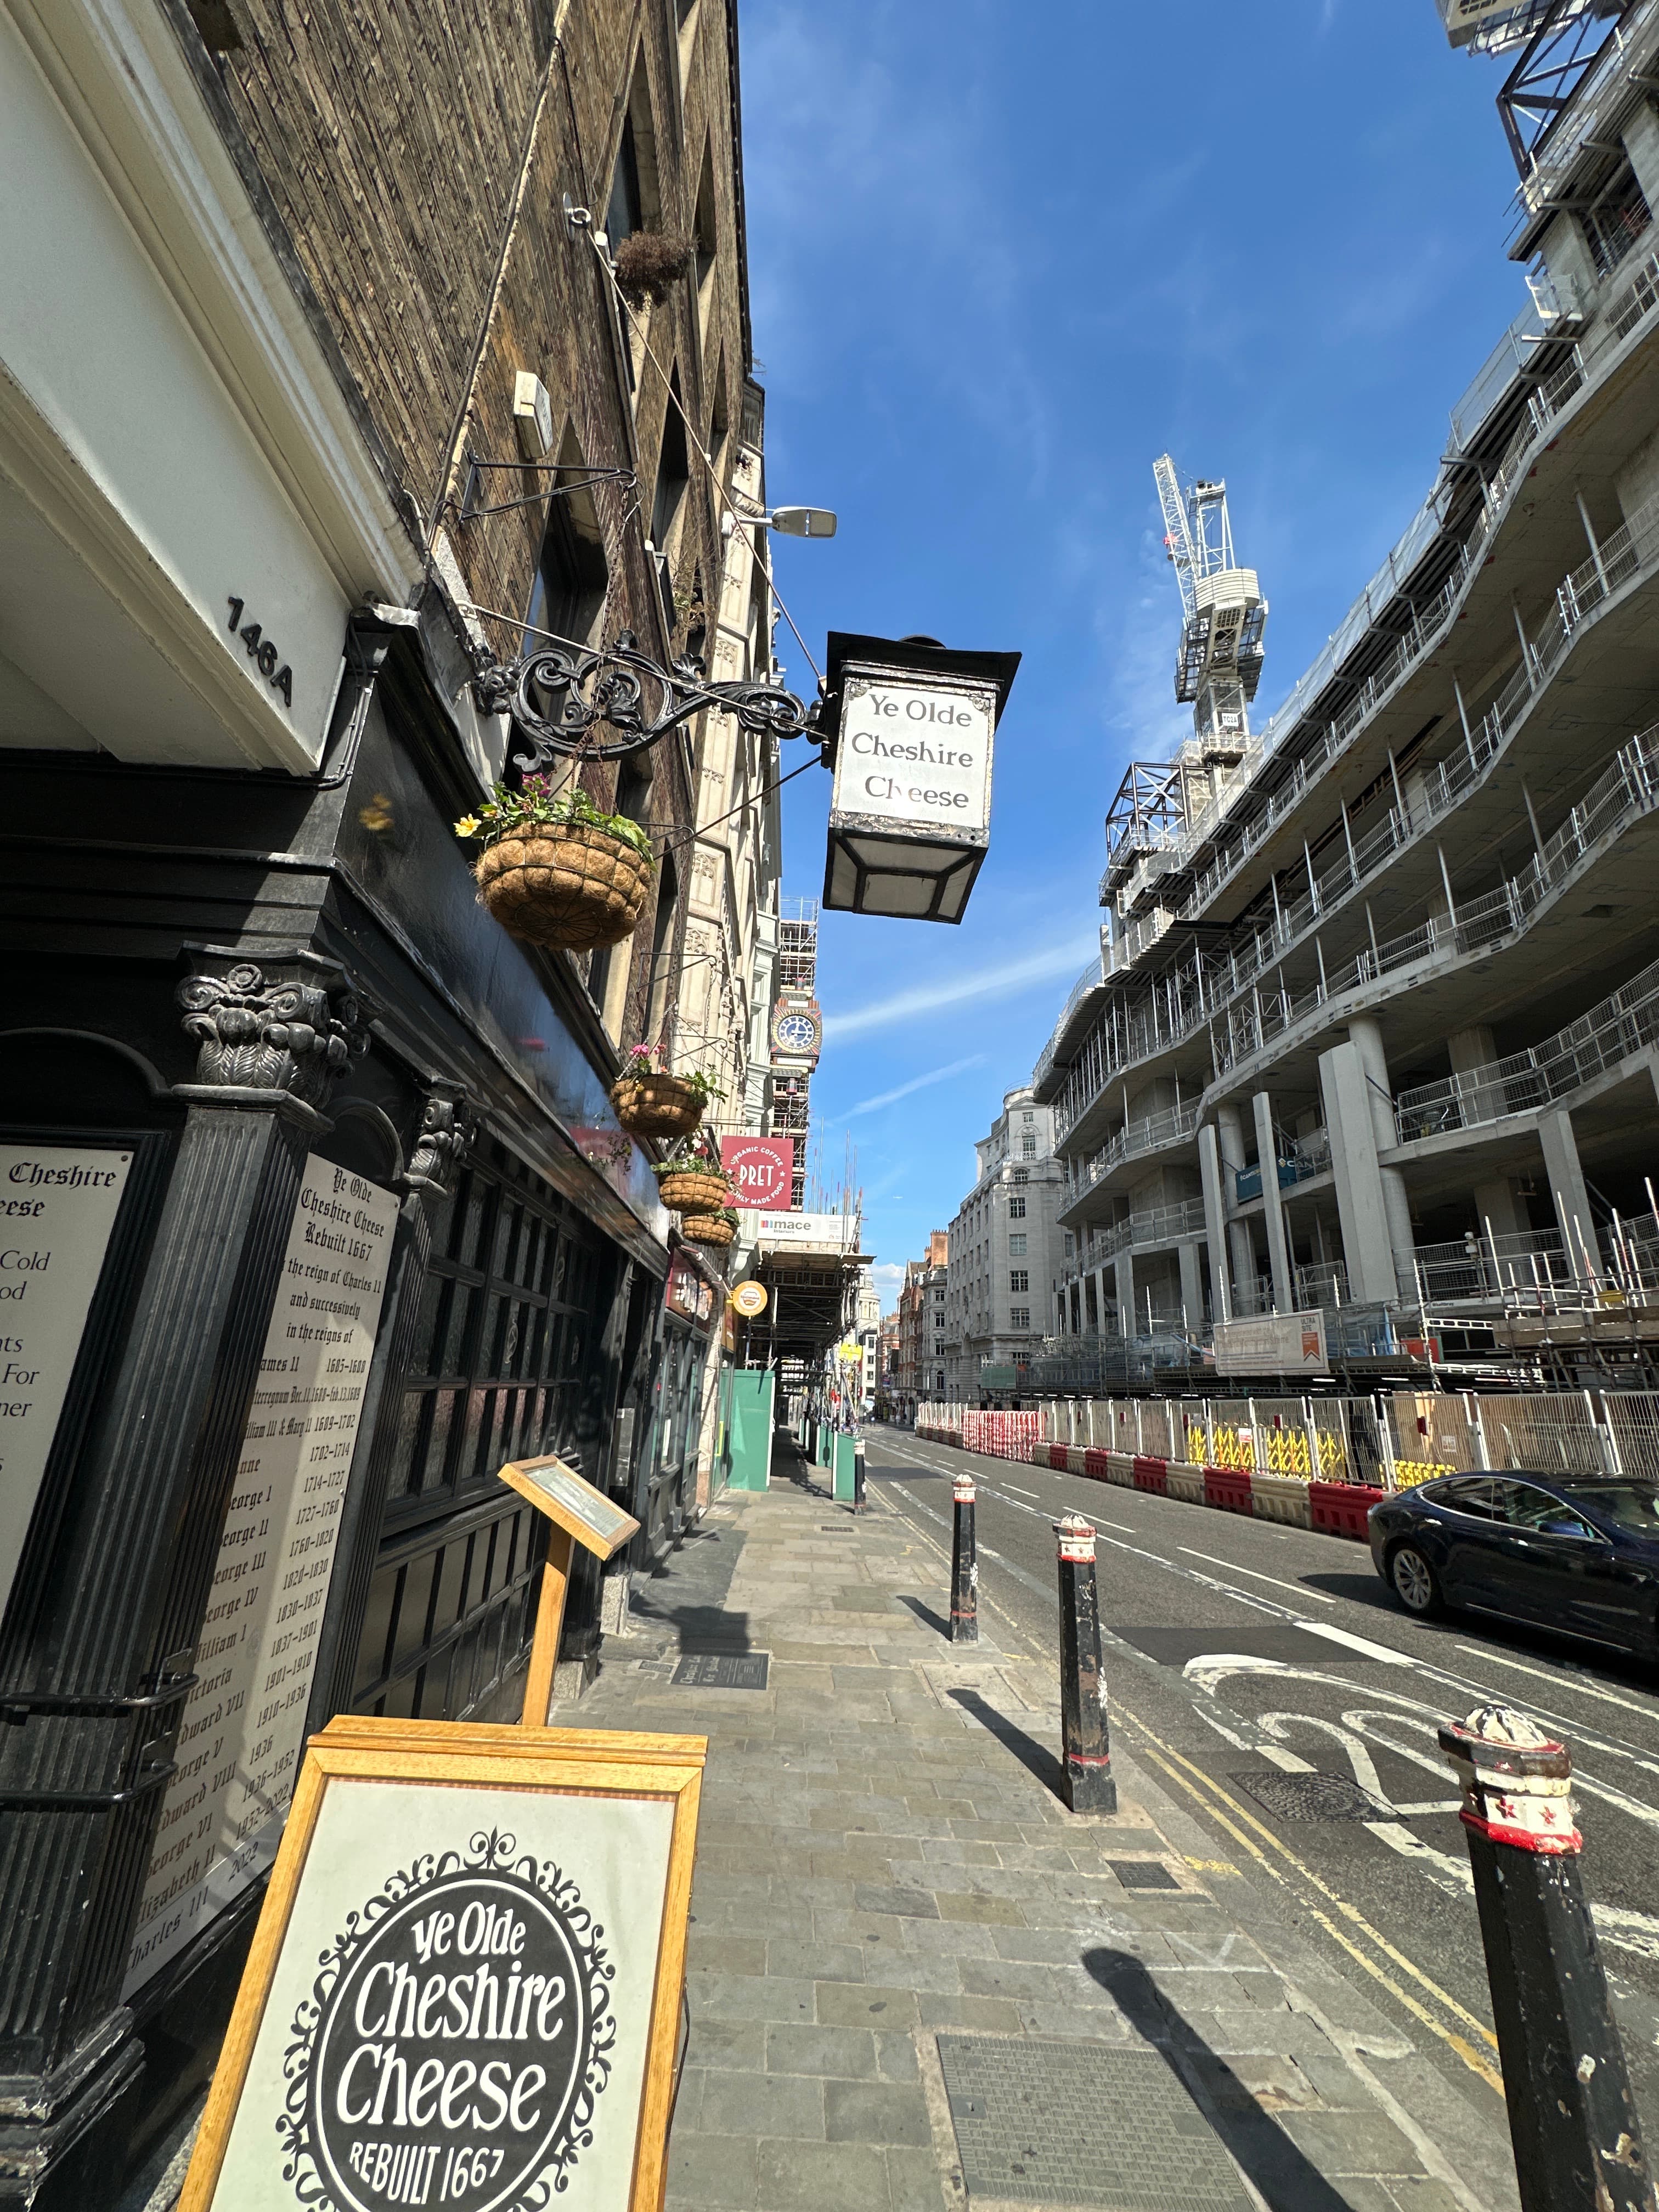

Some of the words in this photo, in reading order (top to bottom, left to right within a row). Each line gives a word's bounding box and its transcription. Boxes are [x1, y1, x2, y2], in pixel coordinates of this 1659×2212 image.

[228, 596, 292, 707] 146A
[868, 694, 899, 717] Ye
[906, 701, 972, 727] Olde
[851, 732, 974, 768] Cheshire
[865, 776, 969, 809] Cheese
[730, 1146, 759, 1165] ORGANIC
[760, 1147, 783, 1167] COFFEE
[9, 1162, 117, 1190] Cheshire
[333, 1167, 347, 1194] Ye
[351, 1176, 372, 1203] Olde
[739, 1164, 774, 1186] PRET
[751, 1195, 771, 1205] MADE
[770, 1181, 785, 1198] FOOD
[301, 1187, 351, 1224] Cheshire
[354, 1209, 384, 1238] Cheese
[774, 1220, 811, 1230] mace
[304, 1221, 346, 1252] Rebuilt
[348, 1239, 373, 1261] 1667
[1, 1250, 51, 1271] Cold
[287, 1257, 303, 1278] the
[305, 1265, 329, 1284] reign
[330, 1269, 341, 1284] of
[343, 1271, 371, 1291] Charles
[290, 1291, 308, 1307] and
[309, 1297, 360, 1320] successively
[286, 1323, 296, 1338] in
[298, 1323, 312, 1343] the
[314, 1327, 341, 1345] reigns
[343, 1329, 354, 1344] of
[2, 1363, 40, 1385] For
[260, 1358, 288, 1372] ames
[254, 1390, 289, 1408] terregnum
[246, 1421, 266, 1439] illiam
[286, 1418, 305, 1438] Mary
[239, 1458, 261, 1475] nne
[230, 1491, 263, 1510] eorge
[222, 1526, 256, 1547] eorge
[214, 1561, 248, 1584] eorge
[206, 1598, 241, 1623] eorge
[188, 1668, 233, 1704] ictoria
[180, 1702, 223, 1745] dward
[162, 1782, 206, 1831] dward
[249, 1735, 273, 1765] 1936
[149, 1832, 193, 1877] eorge
[131, 1909, 184, 1970] harles
[228, 1841, 259, 1882] 2022
[139, 1857, 200, 1923] lizabeth
[459, 1901, 527, 1956] Olde
[354, 1960, 567, 2042] Cheshire
[336, 2044, 546, 2132] Cheese
[349, 2141, 442, 2205] REBUILT
[440, 2147, 505, 2203] 1667
